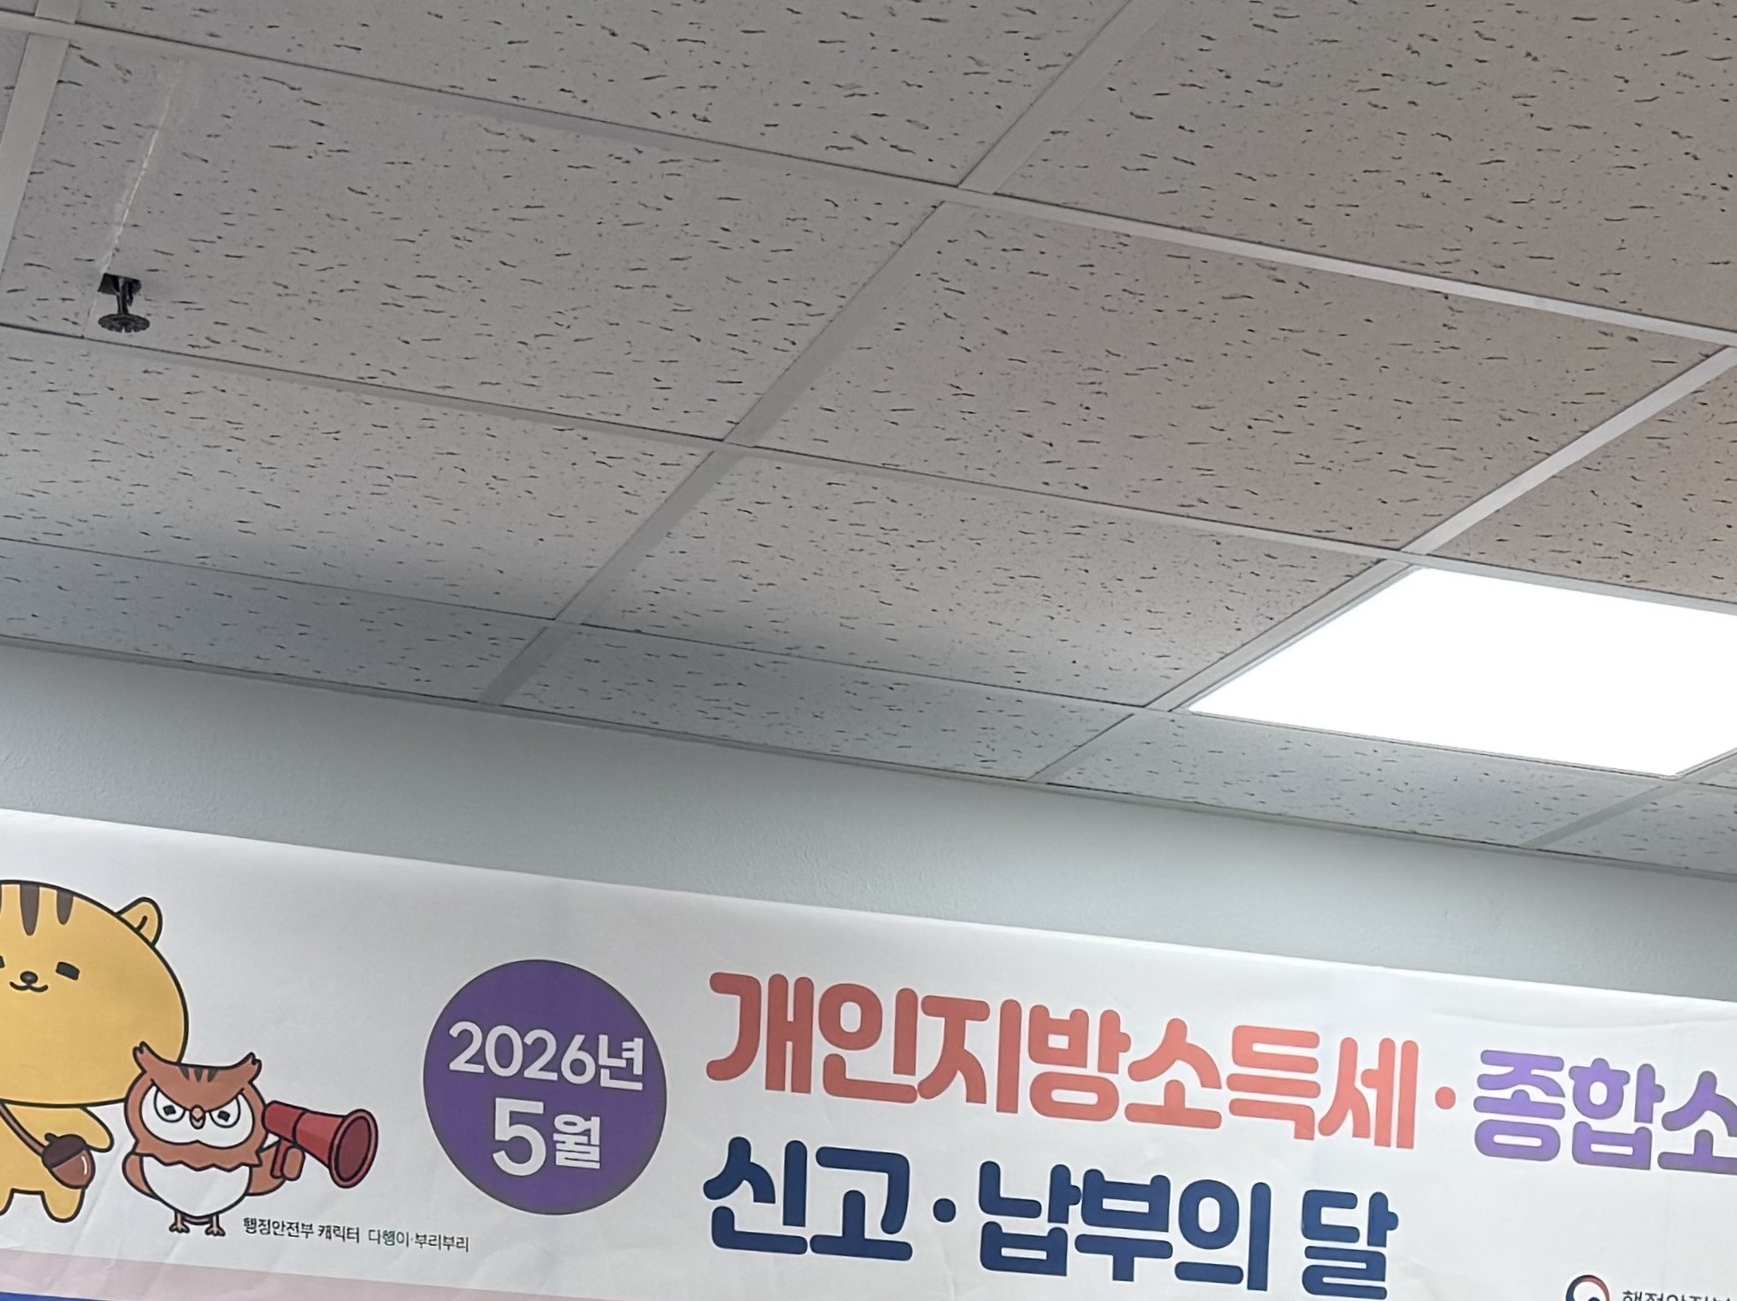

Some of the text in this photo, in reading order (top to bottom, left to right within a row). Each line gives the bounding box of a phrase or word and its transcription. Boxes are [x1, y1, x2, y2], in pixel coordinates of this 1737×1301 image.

[447, 1020, 645, 1092] 2026년
[492, 1097, 603, 1177] 5월
[243, 1217, 314, 1239] 행정안전부
[318, 1224, 360, 1243] 캐릭터
[702, 1136, 1400, 1301] 신고·납부의 달
